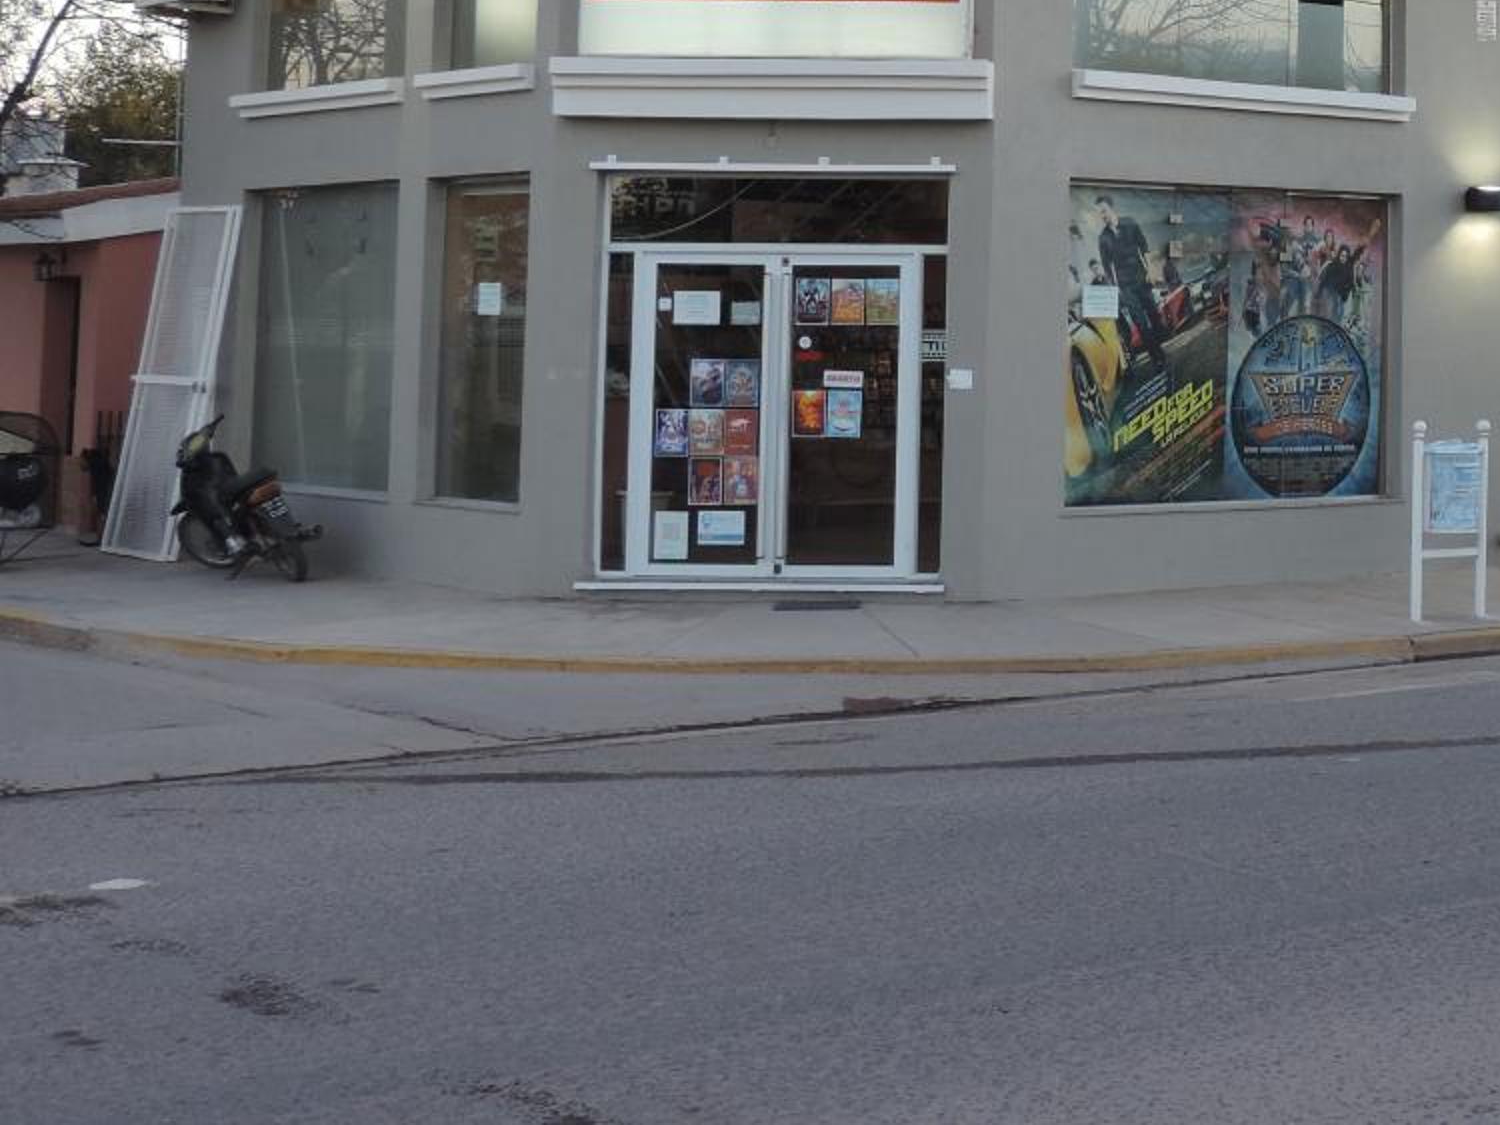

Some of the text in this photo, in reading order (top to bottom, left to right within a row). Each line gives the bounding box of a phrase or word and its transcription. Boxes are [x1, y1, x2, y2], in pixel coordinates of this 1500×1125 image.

[1151, 379, 1213, 443] SPEED
[1262, 376, 1345, 394] SUPER
[1113, 396, 1167, 452] NEED
